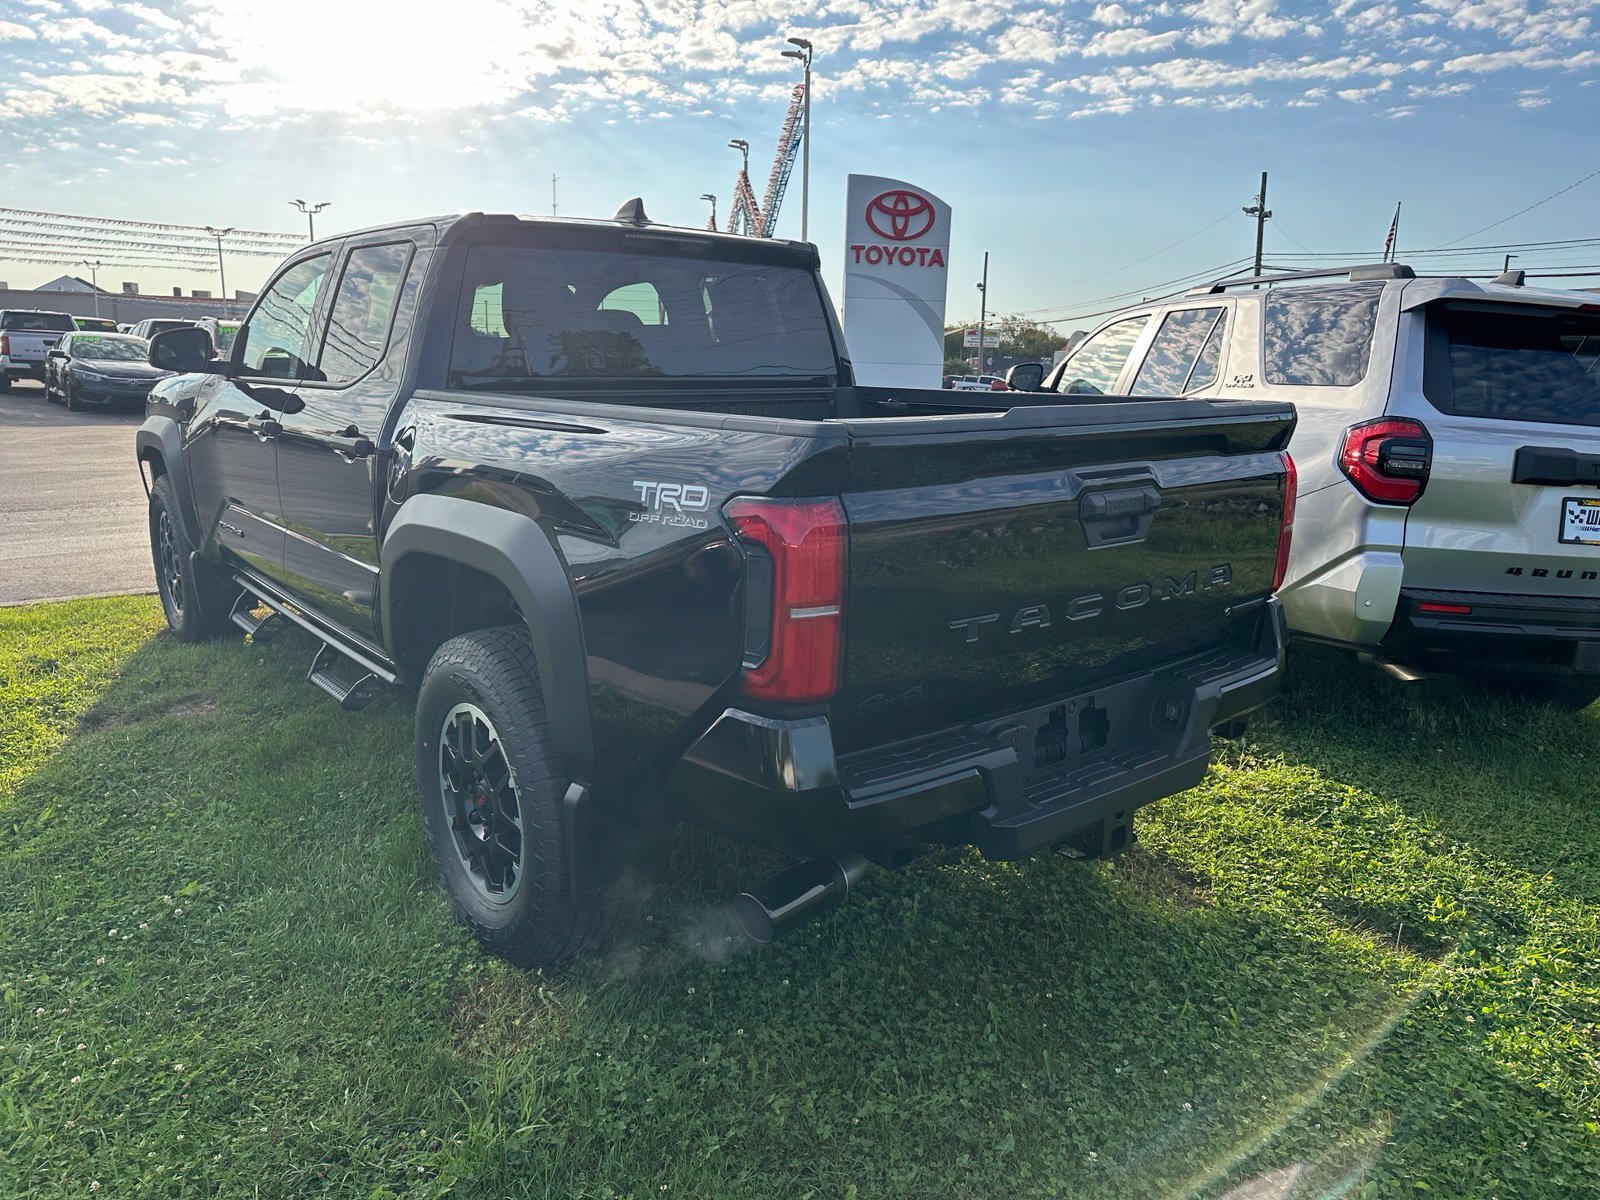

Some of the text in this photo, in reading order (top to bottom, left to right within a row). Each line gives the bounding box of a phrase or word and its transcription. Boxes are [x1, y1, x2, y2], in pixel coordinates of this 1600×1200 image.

[851, 245, 945, 267] TOYOTA
[632, 480, 711, 512] TRD
[628, 511, 709, 529] OFF ROAD
[948, 563, 1232, 642] TACOMA
